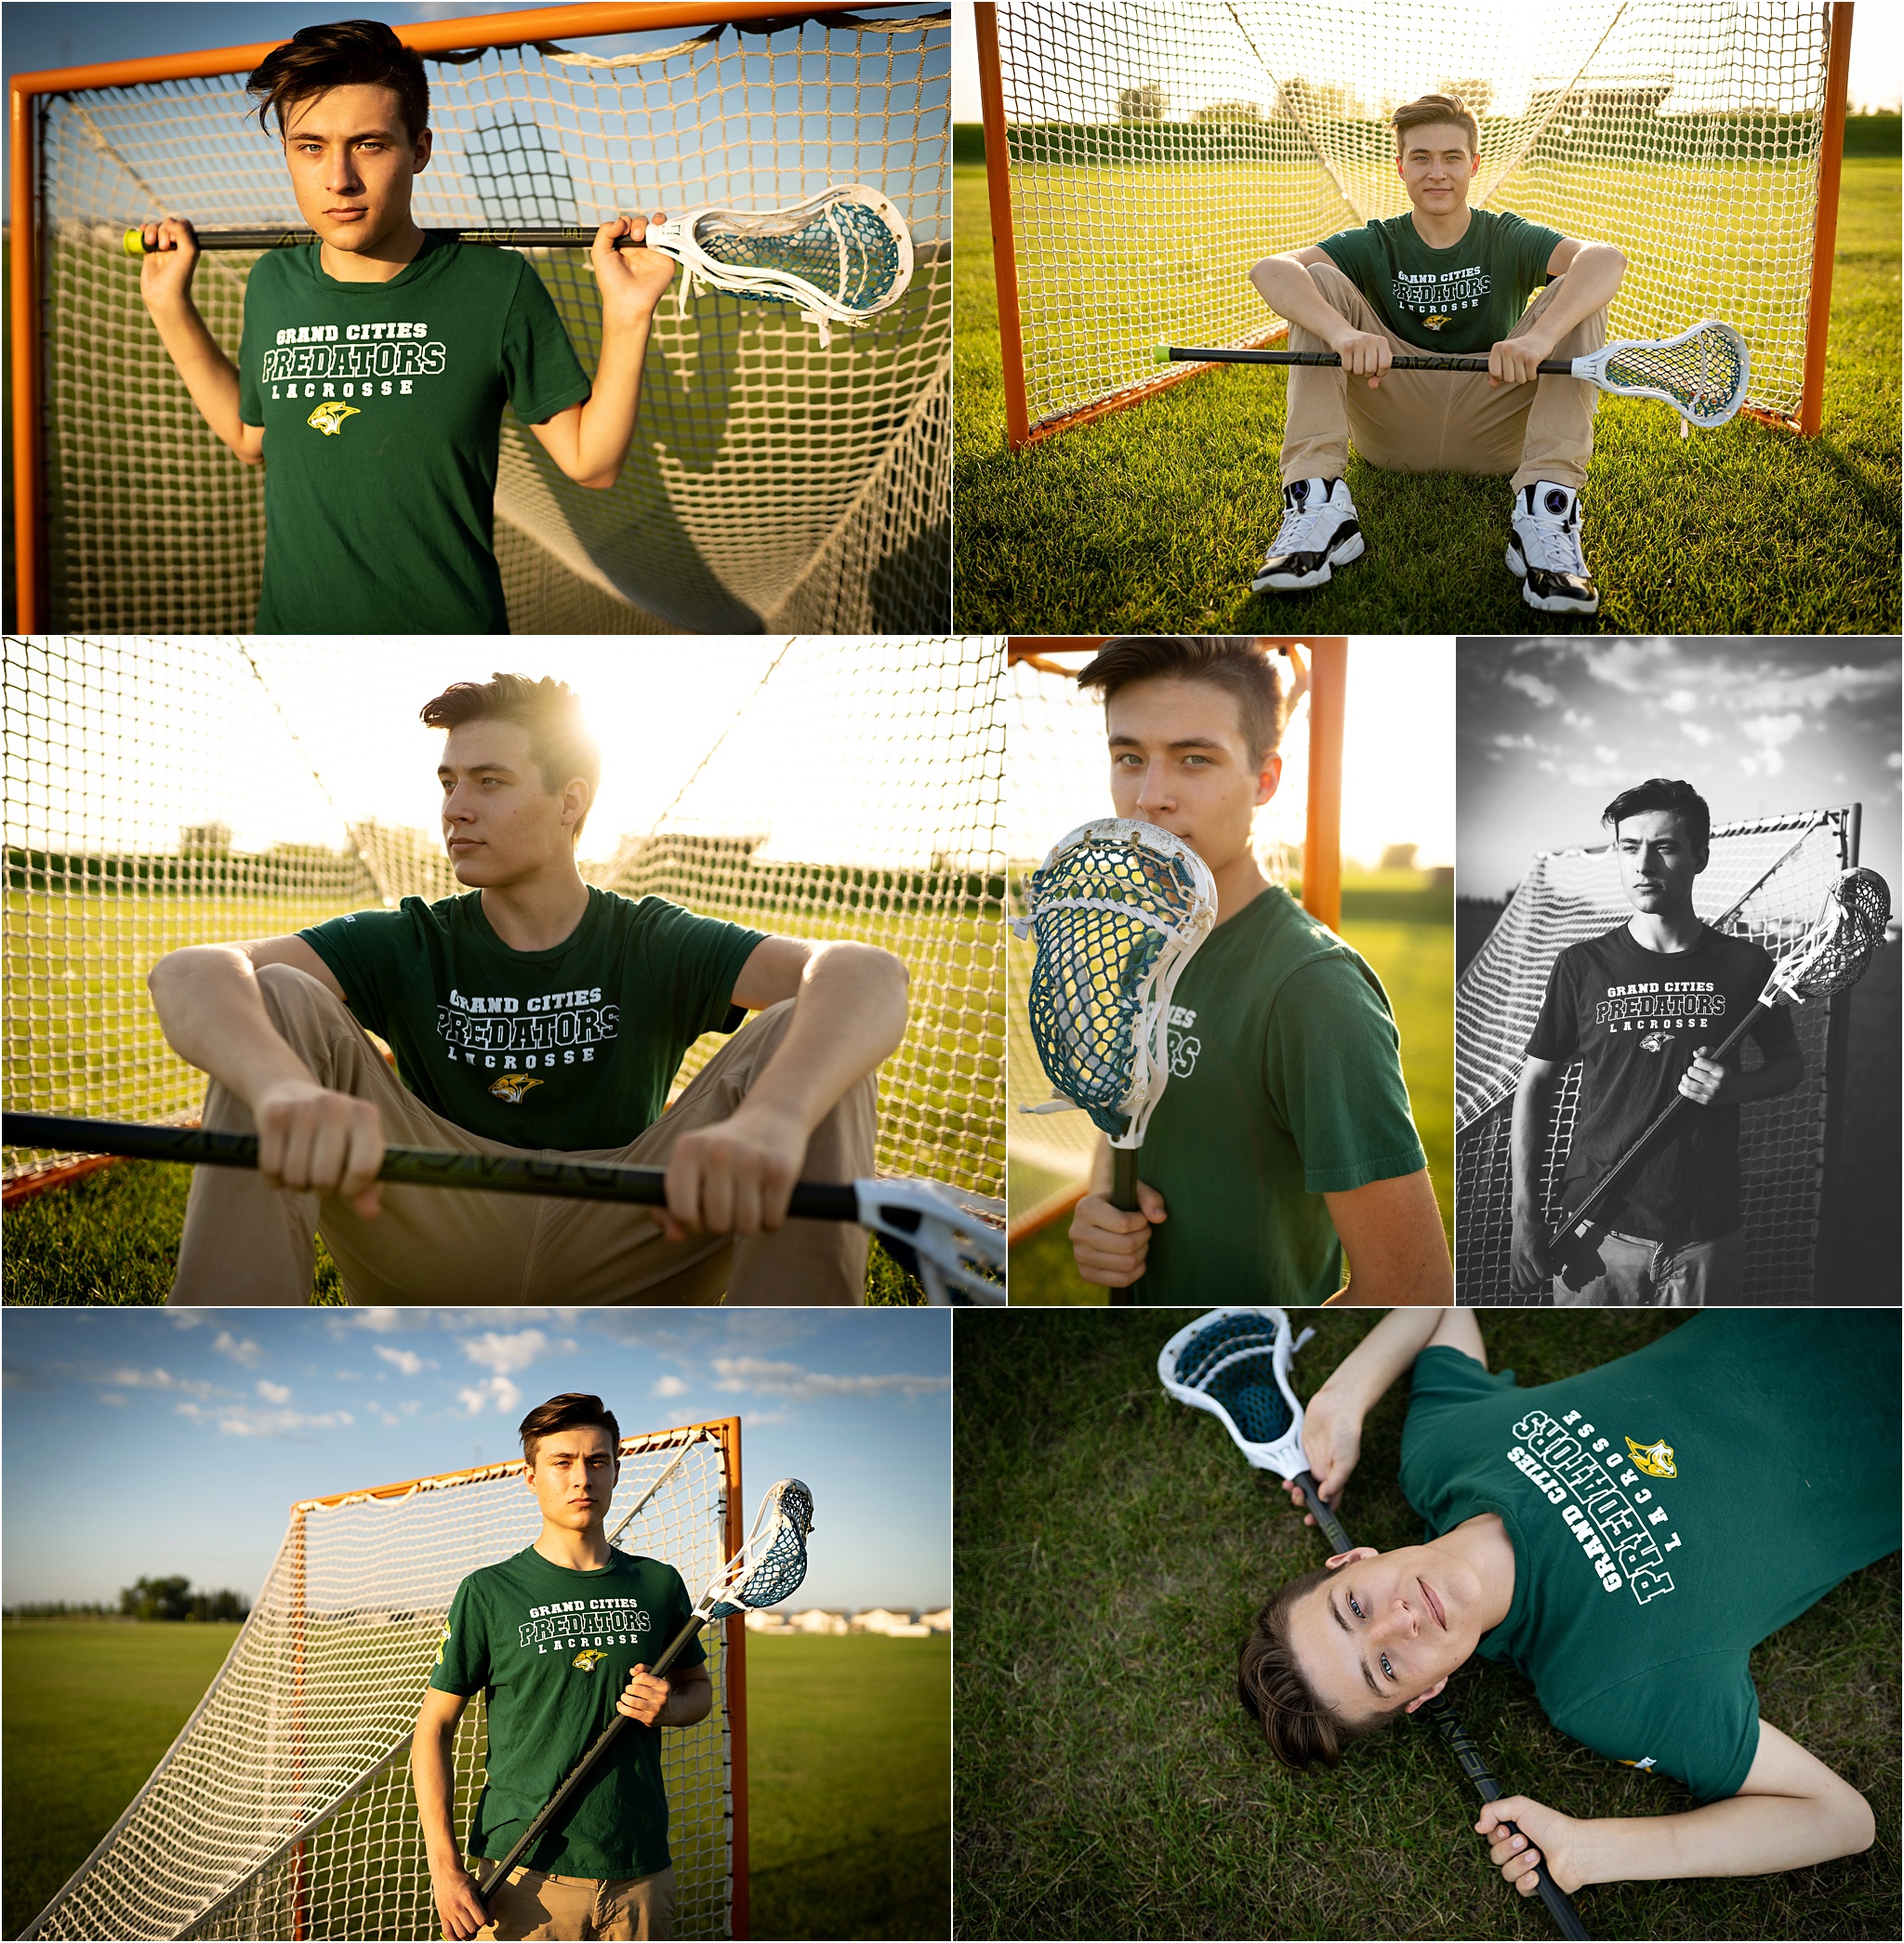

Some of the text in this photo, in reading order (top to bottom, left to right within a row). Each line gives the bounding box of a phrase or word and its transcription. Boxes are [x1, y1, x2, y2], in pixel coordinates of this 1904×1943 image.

[1440, 266, 1481, 282] CITIES
[1392, 274, 1491, 303] PREDATORS
[1398, 298, 1478, 313] LACROSSE
[276, 323, 428, 345] GRAND CITIES
[262, 342, 446, 383] PREDATORS
[271, 379, 413, 400] LACROSSE
[449, 987, 602, 1013] GRAND CITIES
[1607, 982, 1714, 998] GRAND CITIES
[1596, 994, 1726, 1024] PREDATORS
[437, 1004, 620, 1051] PREDATORS
[1609, 1018, 1708, 1033] LACROSSE
[448, 1046, 594, 1069] LACROSSE
[1562, 1409, 1682, 1552] LACROSSE
[1513, 1409, 1675, 1606] PREDATORS
[1507, 1447, 1622, 1593] GRAND CITIES
[529, 1598, 638, 1619] GRAND CITIES
[519, 1610, 651, 1647] PREDATORS
[538, 1634, 638, 1654] LACROSSE
